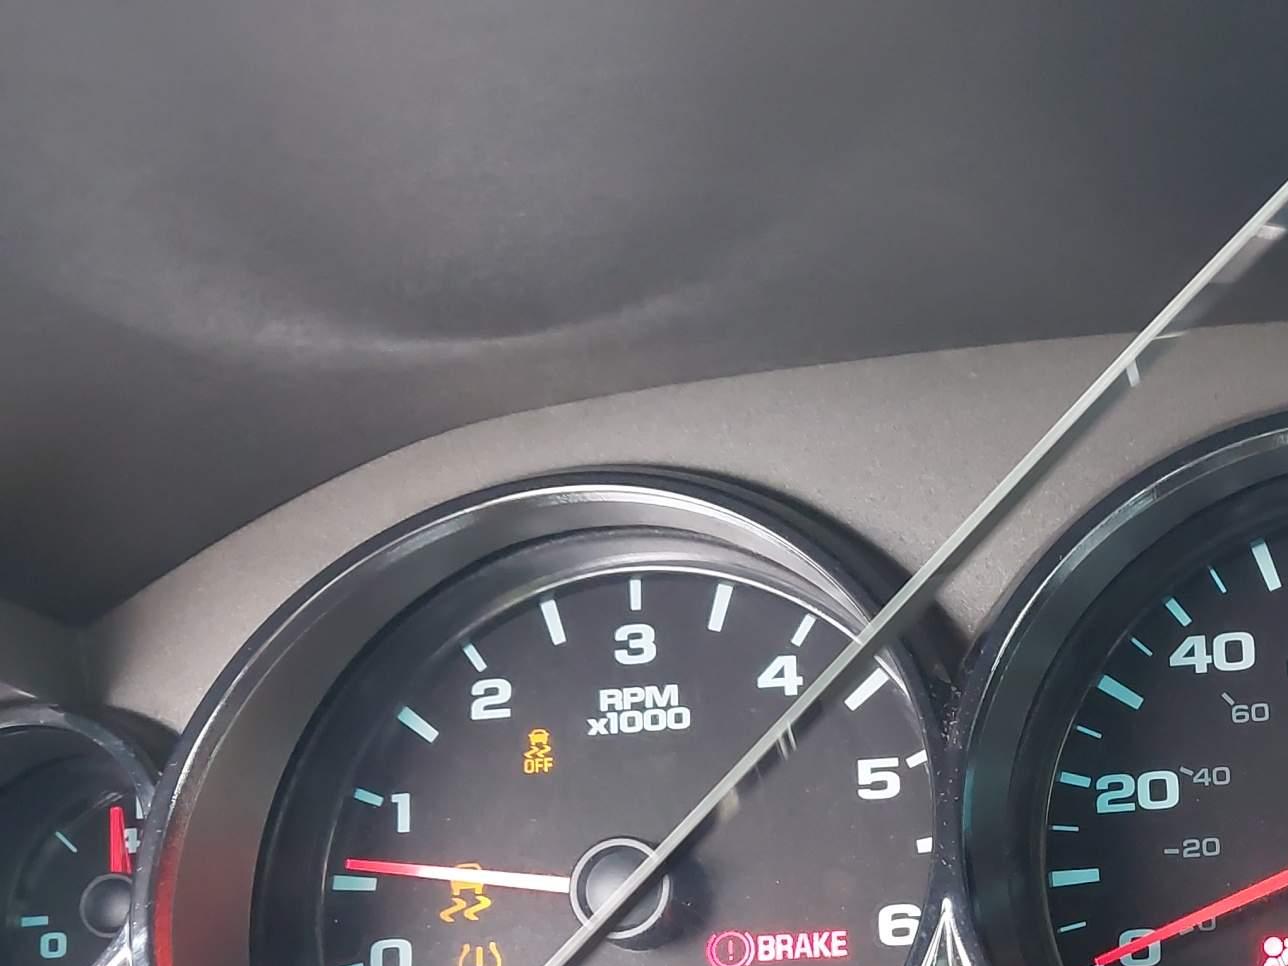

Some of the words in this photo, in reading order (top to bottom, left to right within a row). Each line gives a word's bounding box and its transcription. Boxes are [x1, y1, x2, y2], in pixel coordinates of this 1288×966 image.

[615, 624, 656, 664] 3
[1170, 632, 1255, 673] 40
[757, 655, 802, 697] 4
[471, 679, 511, 720] 2
[599, 684, 679, 709] RPM
[1232, 703, 1269, 723] 60
[587, 707, 690, 735] x1000
[523, 758, 553, 774] OFF
[858, 758, 900, 799] 5
[1193, 767, 1230, 785] 40
[1096, 771, 1179, 813] 20
[392, 793, 410, 832] 1
[1183, 838, 1220, 857] 20
[879, 904, 921, 945] 6
[41, 933, 67, 958] 0
[757, 931, 847, 961] BRAKE
